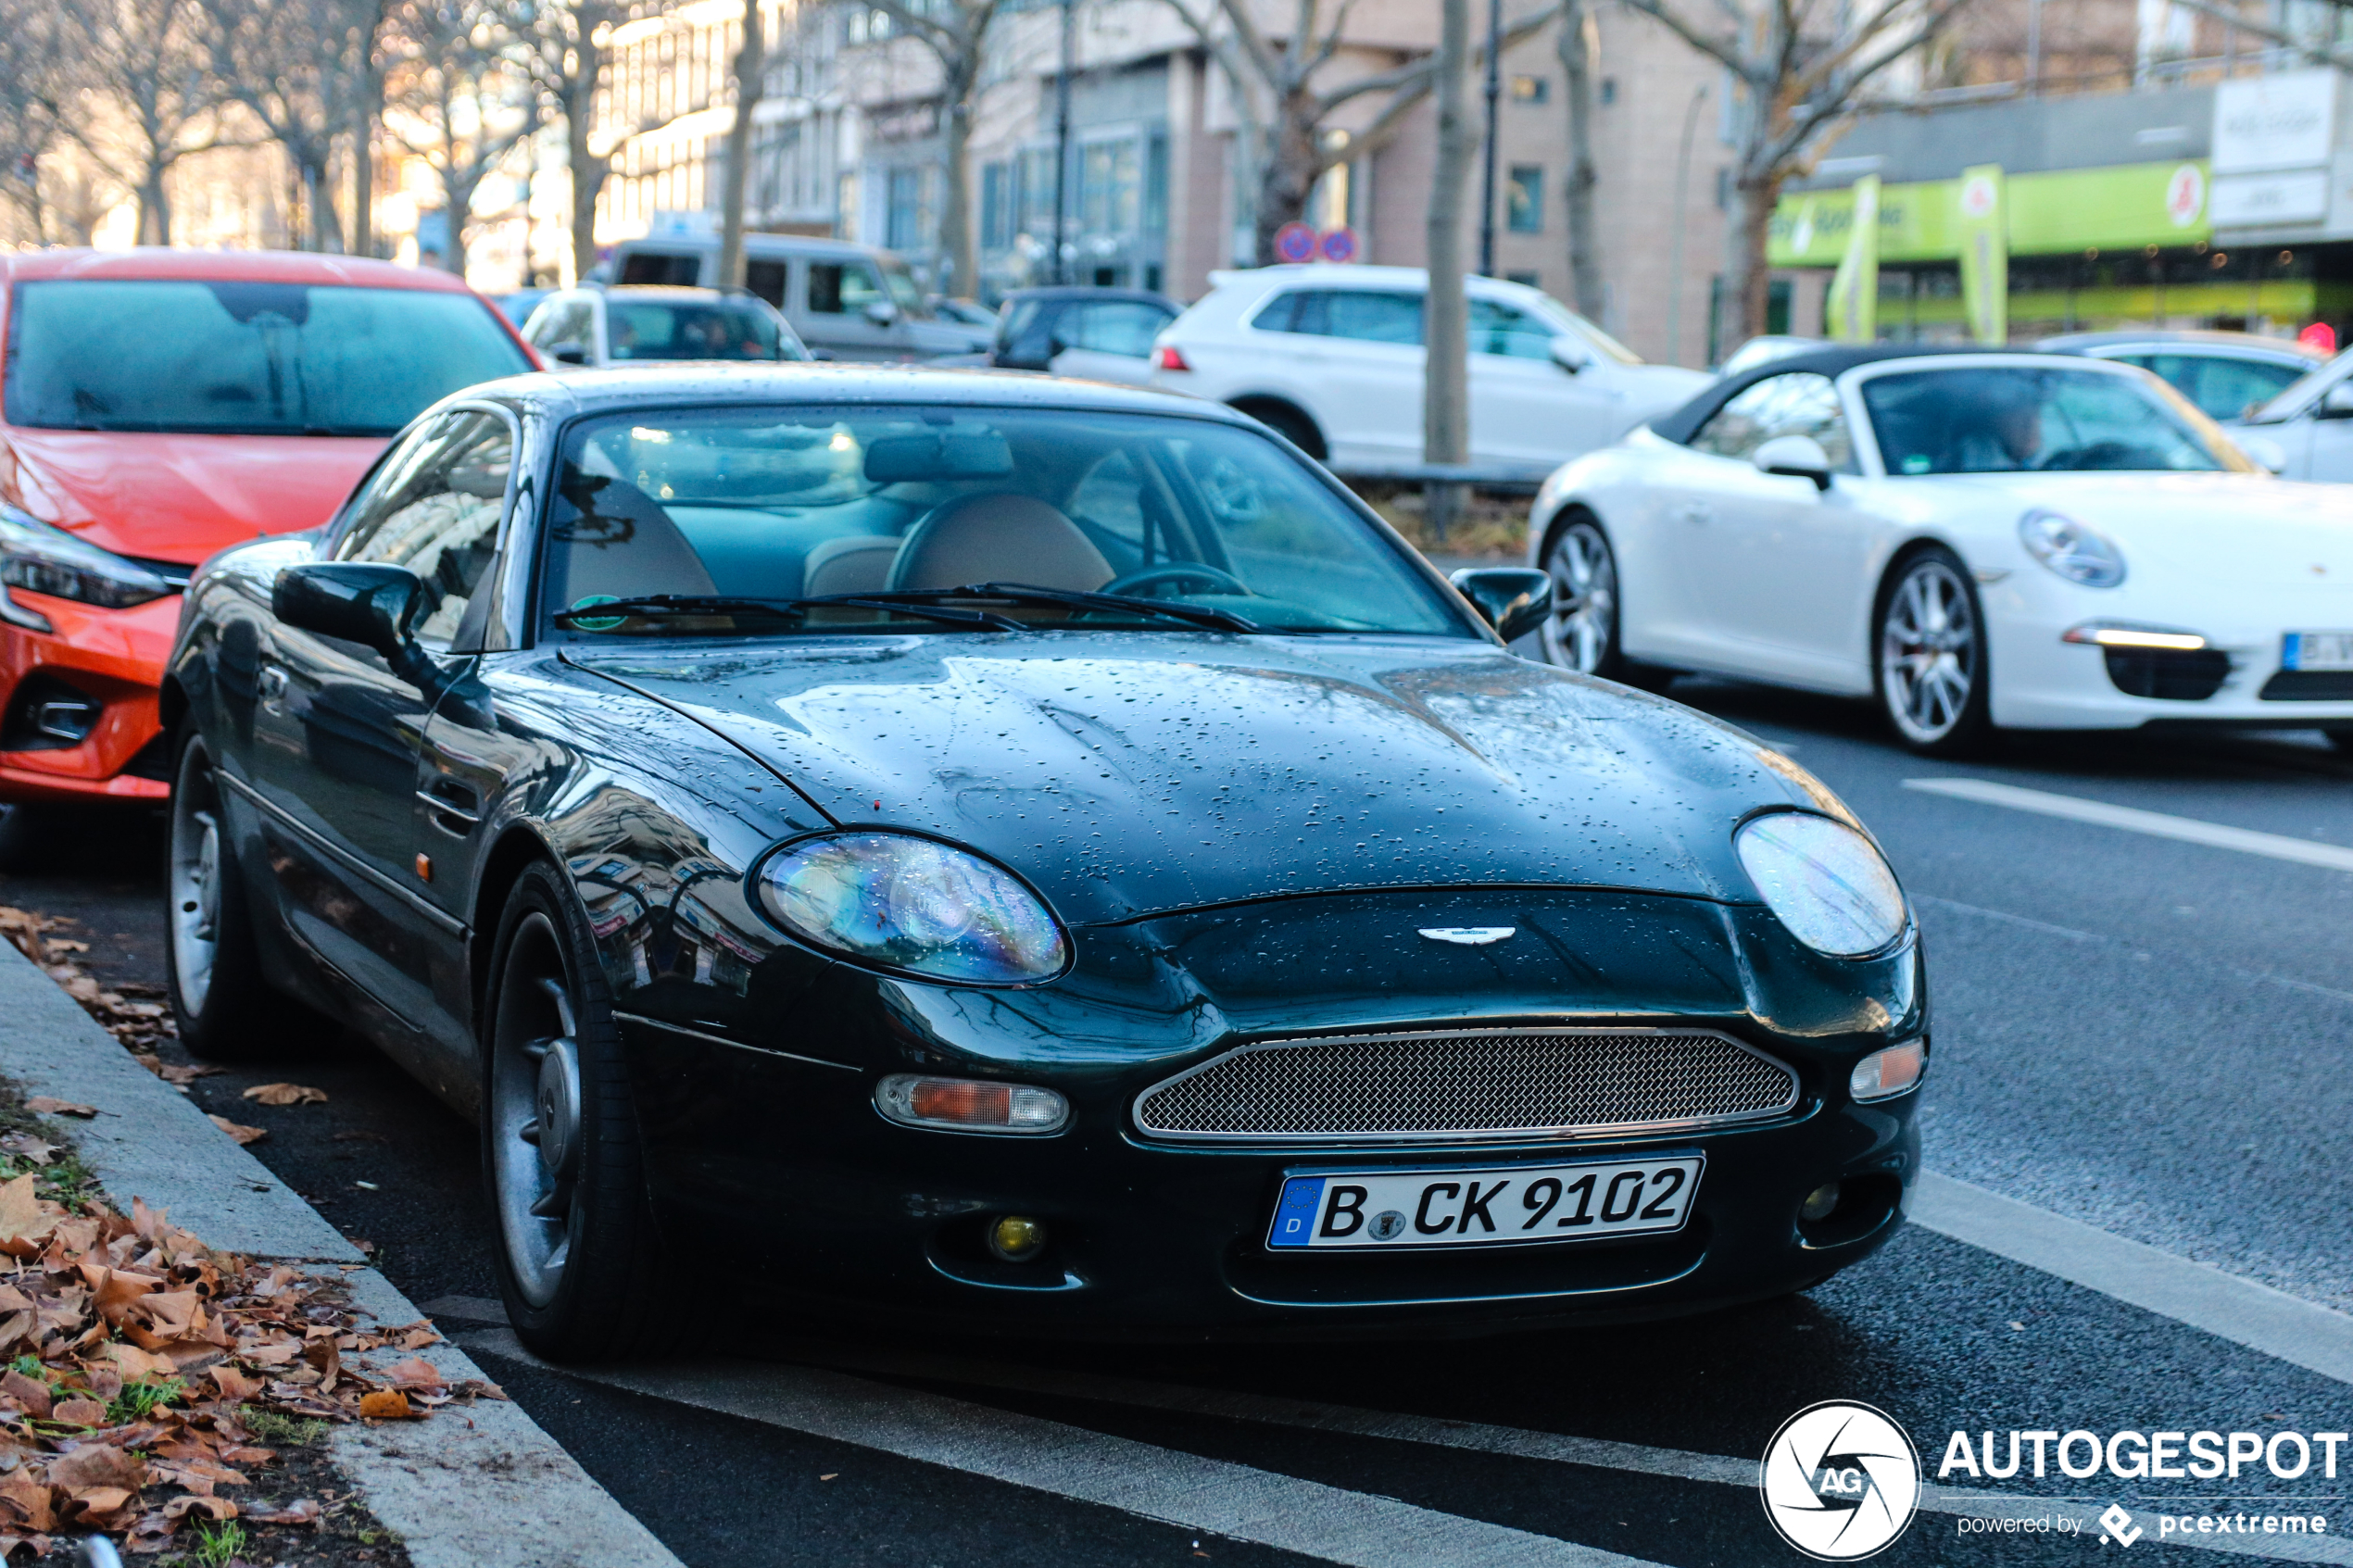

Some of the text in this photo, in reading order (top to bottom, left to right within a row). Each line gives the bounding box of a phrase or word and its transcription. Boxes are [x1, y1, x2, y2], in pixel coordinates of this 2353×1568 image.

[1320, 1167, 1687, 1237] B CK 9102
[1286, 1218, 1302, 1233] D
